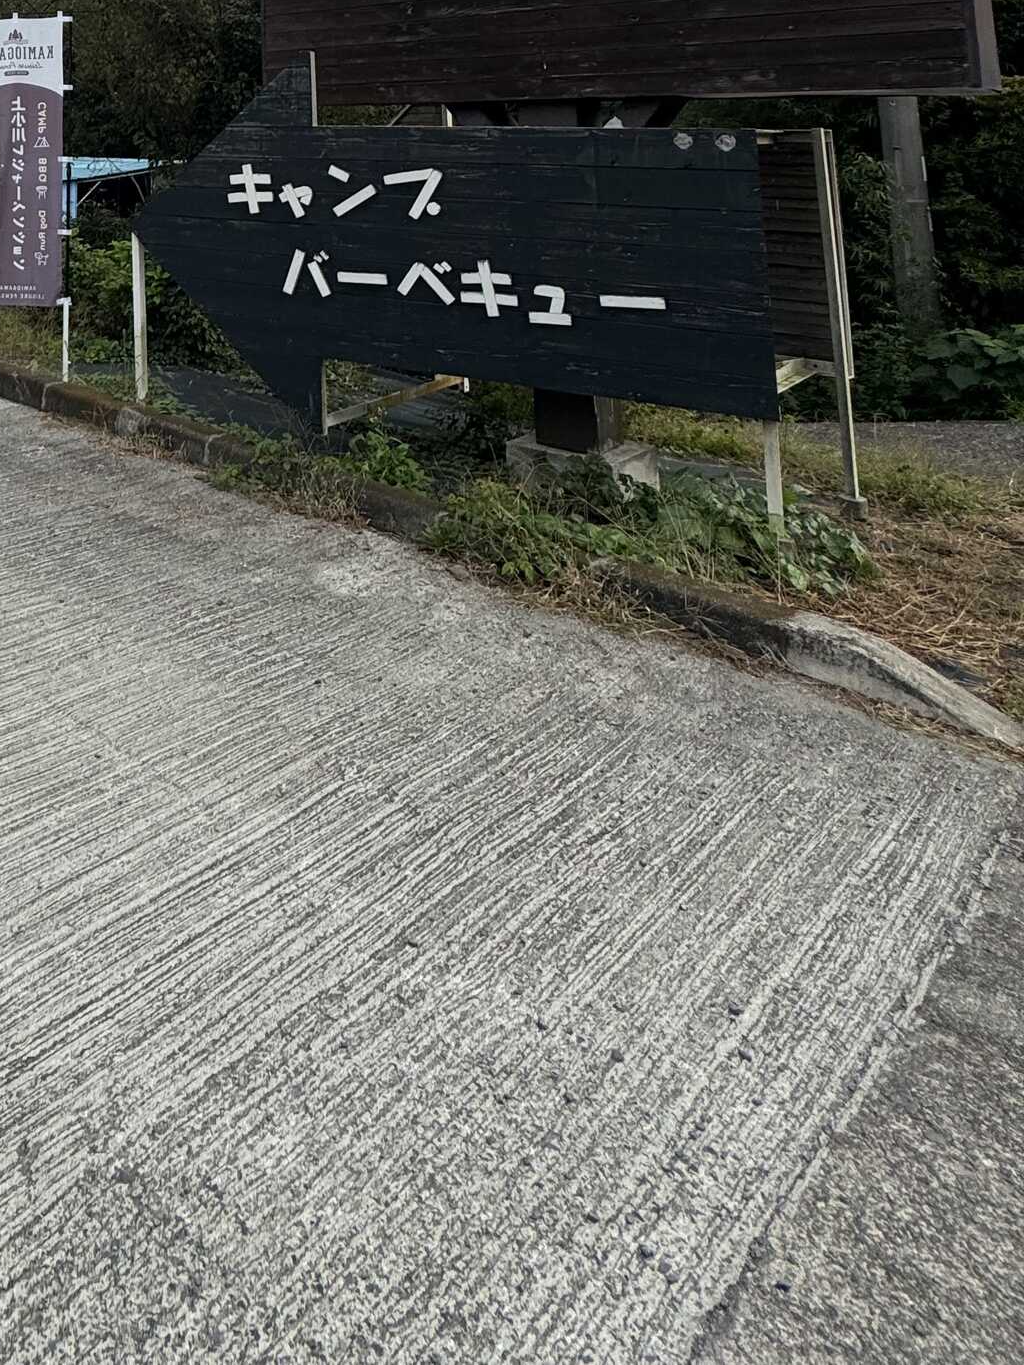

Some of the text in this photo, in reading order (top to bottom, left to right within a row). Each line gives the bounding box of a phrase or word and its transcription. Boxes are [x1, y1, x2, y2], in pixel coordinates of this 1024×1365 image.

[226, 163, 444, 220] キャンプ
[282, 248, 667, 326] バーベキュー
